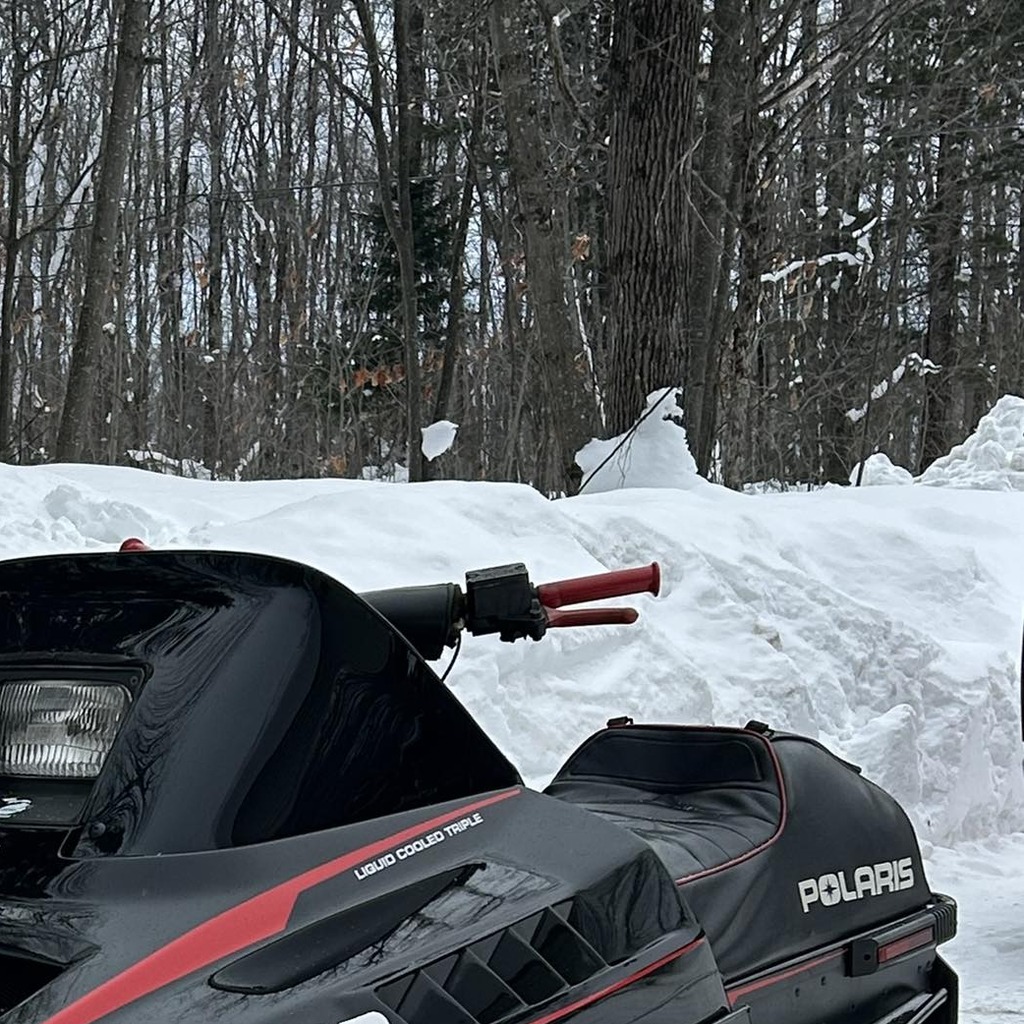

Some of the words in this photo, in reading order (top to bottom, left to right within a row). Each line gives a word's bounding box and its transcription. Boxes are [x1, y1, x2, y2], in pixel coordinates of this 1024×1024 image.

[354, 853, 397, 881] LIQUID
[396, 832, 445, 861] COOLED
[444, 812, 484, 837] TRIPLE
[798, 857, 915, 913] POLARIS
